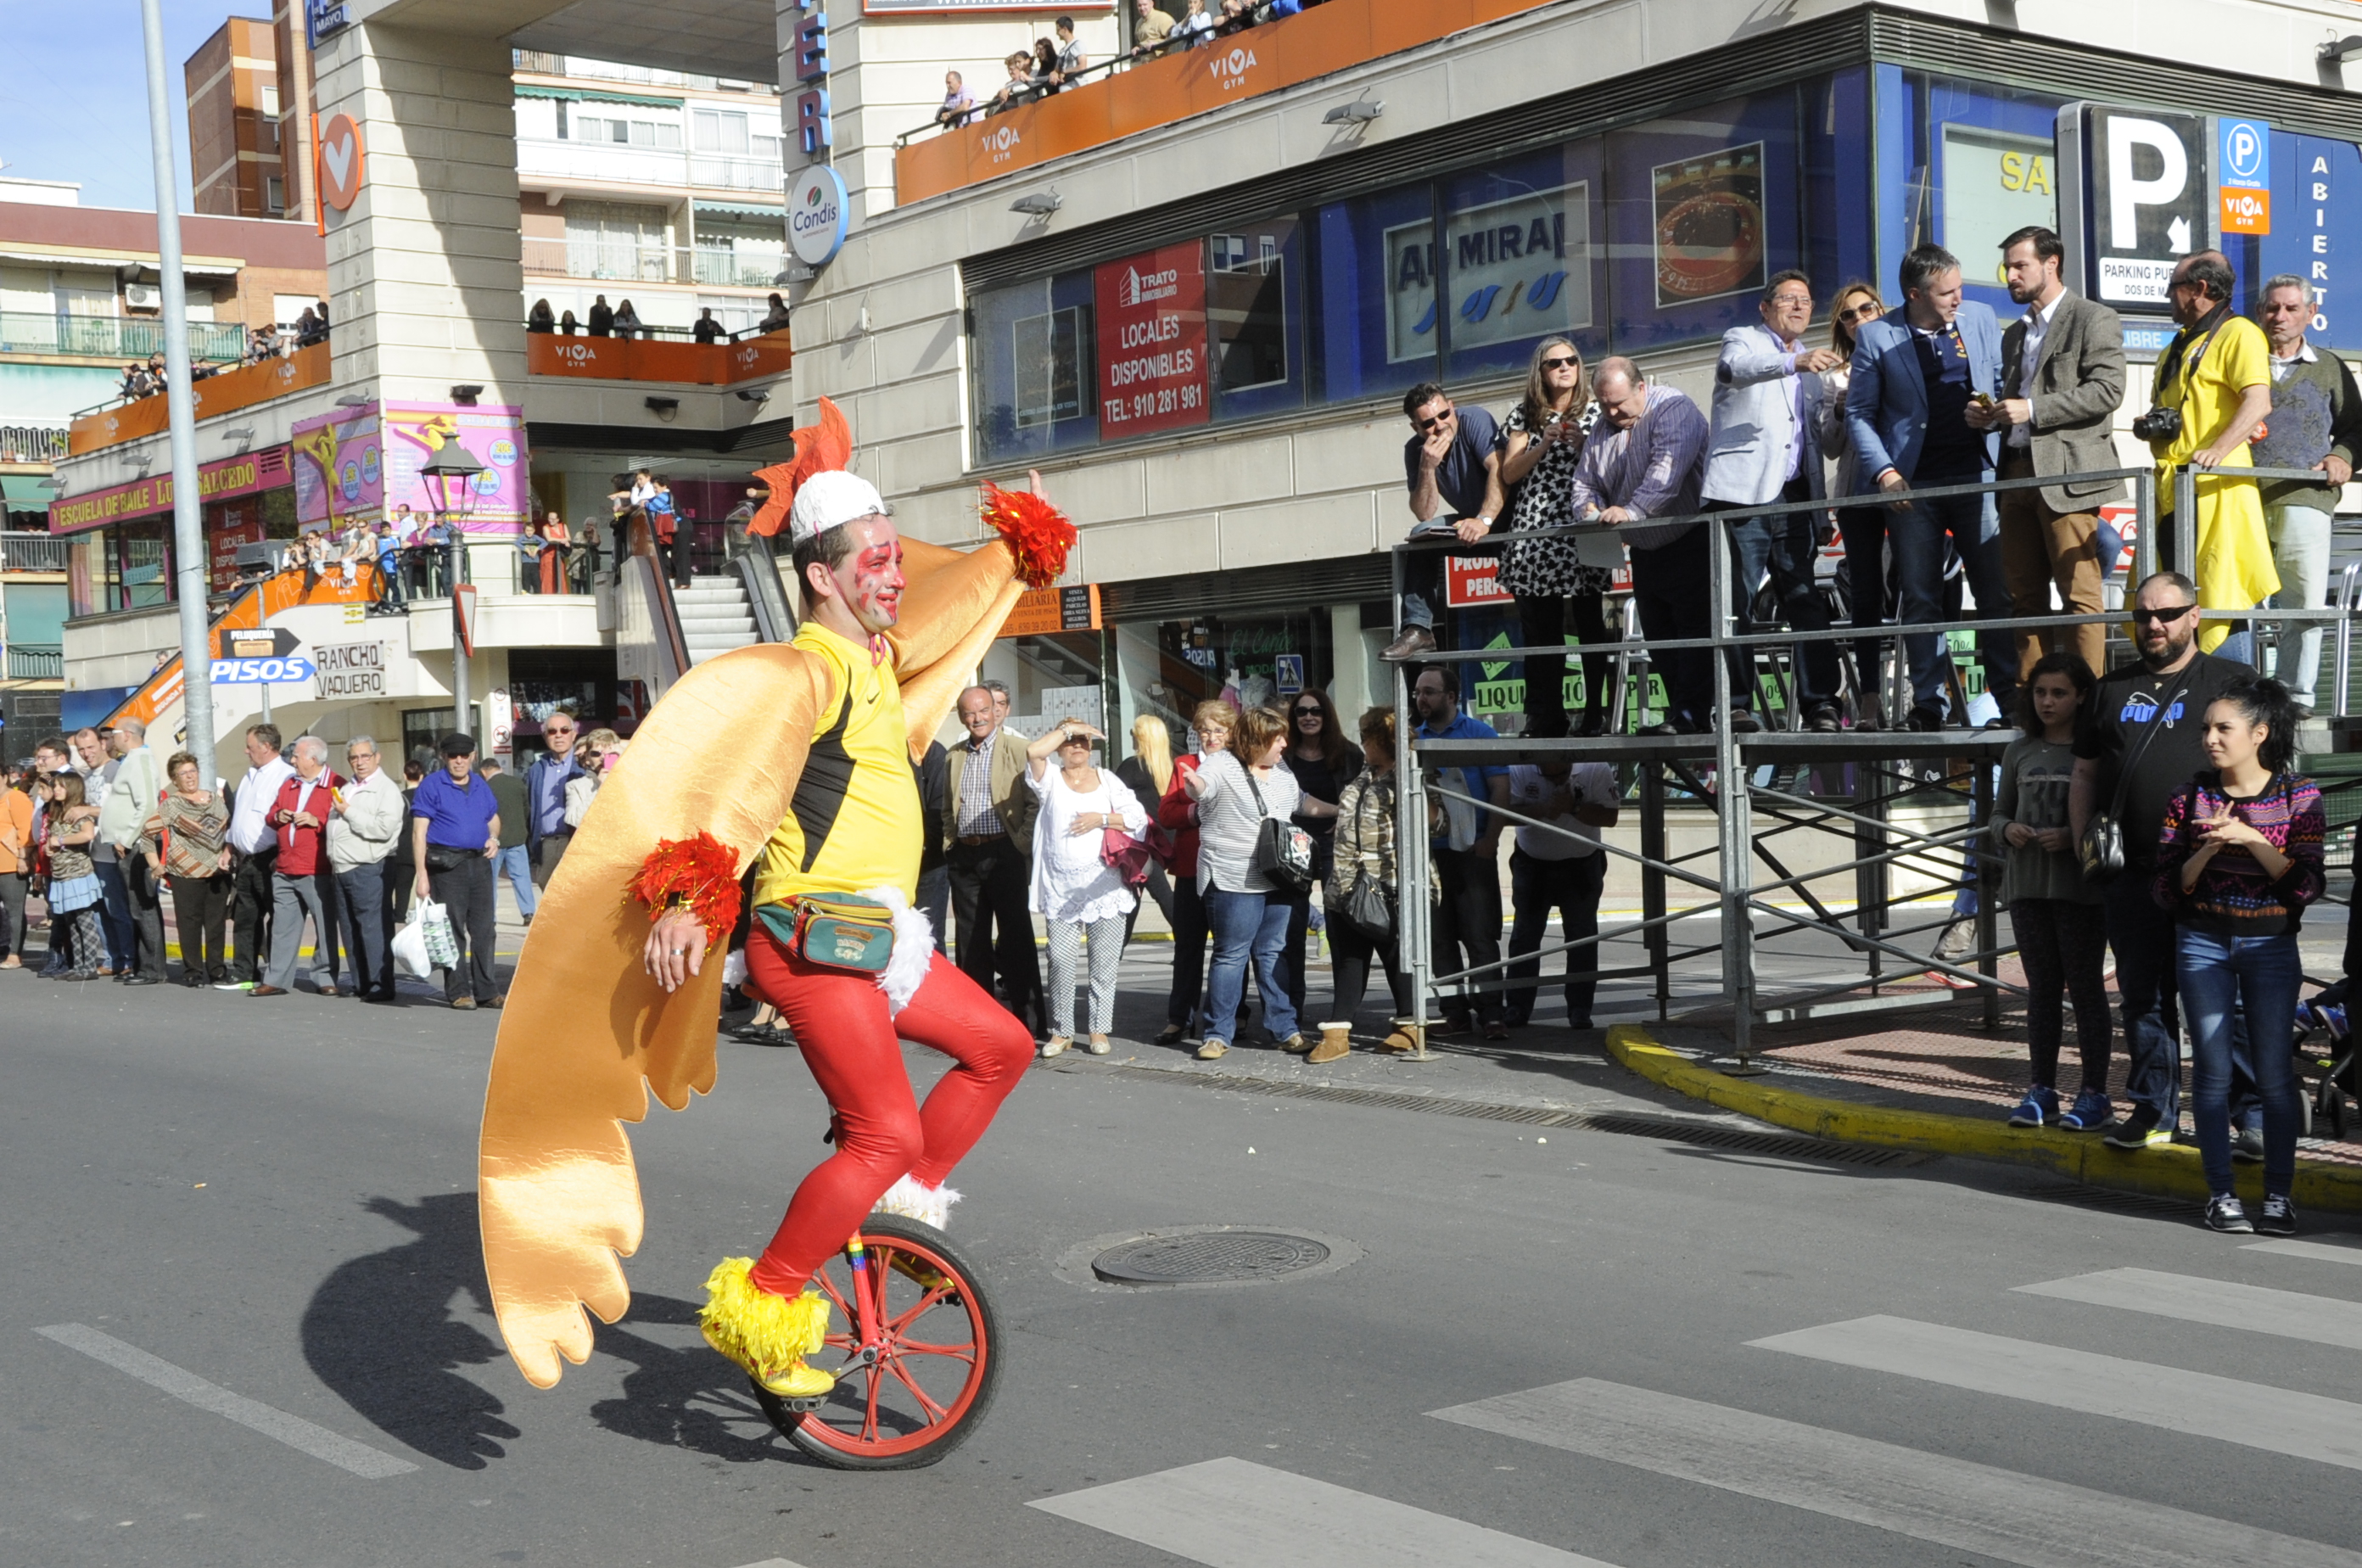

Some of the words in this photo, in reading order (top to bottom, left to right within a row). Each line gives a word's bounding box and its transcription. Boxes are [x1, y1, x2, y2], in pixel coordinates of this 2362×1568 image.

[316, 11, 342, 32] MAYO
[1210, 48, 1257, 79] VIVA
[1223, 76, 1245, 90] GYM
[982, 126, 1020, 153] VIVA
[2236, 132, 2254, 166] P
[993, 151, 1010, 163] GYM
[2001, 150, 2051, 196] SA
[2107, 115, 2188, 249] P
[2225, 195, 2264, 216] VIVA
[793, 203, 837, 232] Condis
[2236, 217, 2253, 226] GYM
[2311, 155, 2329, 331] ABIERTO
[1141, 269, 1177, 288] TRATO
[2105, 264, 2151, 279] PARKING
[1141, 284, 1177, 302] INMOBILIARIO
[2124, 284, 2142, 294] DOS
[2144, 286, 2155, 295] DE
[1121, 314, 1179, 350] LOCALES
[555, 344, 596, 361] VIVA
[736, 347, 759, 363] VIVA
[277, 361, 296, 378] VIVA
[1111, 348, 1194, 387] DISPONIBLES
[1105, 398, 1132, 423] TEL:
[1133, 392, 1155, 418] 910
[1158, 388, 1178, 414] 281
[1181, 383, 1202, 410] 981
[495, 442, 512, 453] 20€
[59, 500, 104, 527] ESCUELA
[104, 495, 120, 517] DE
[120, 487, 150, 513] BAILE
[220, 534, 246, 550] LOCALES
[329, 576, 359, 589] VIVA
[1016, 593, 1058, 608] BILIARIA
[230, 628, 275, 641] PELUQUERÍA
[1041, 621, 1049, 631] 20
[1050, 620, 1058, 630] 02
[316, 644, 378, 671] RANCHO
[210, 658, 304, 681] PISOS
[316, 672, 381, 696] VAQUERO
